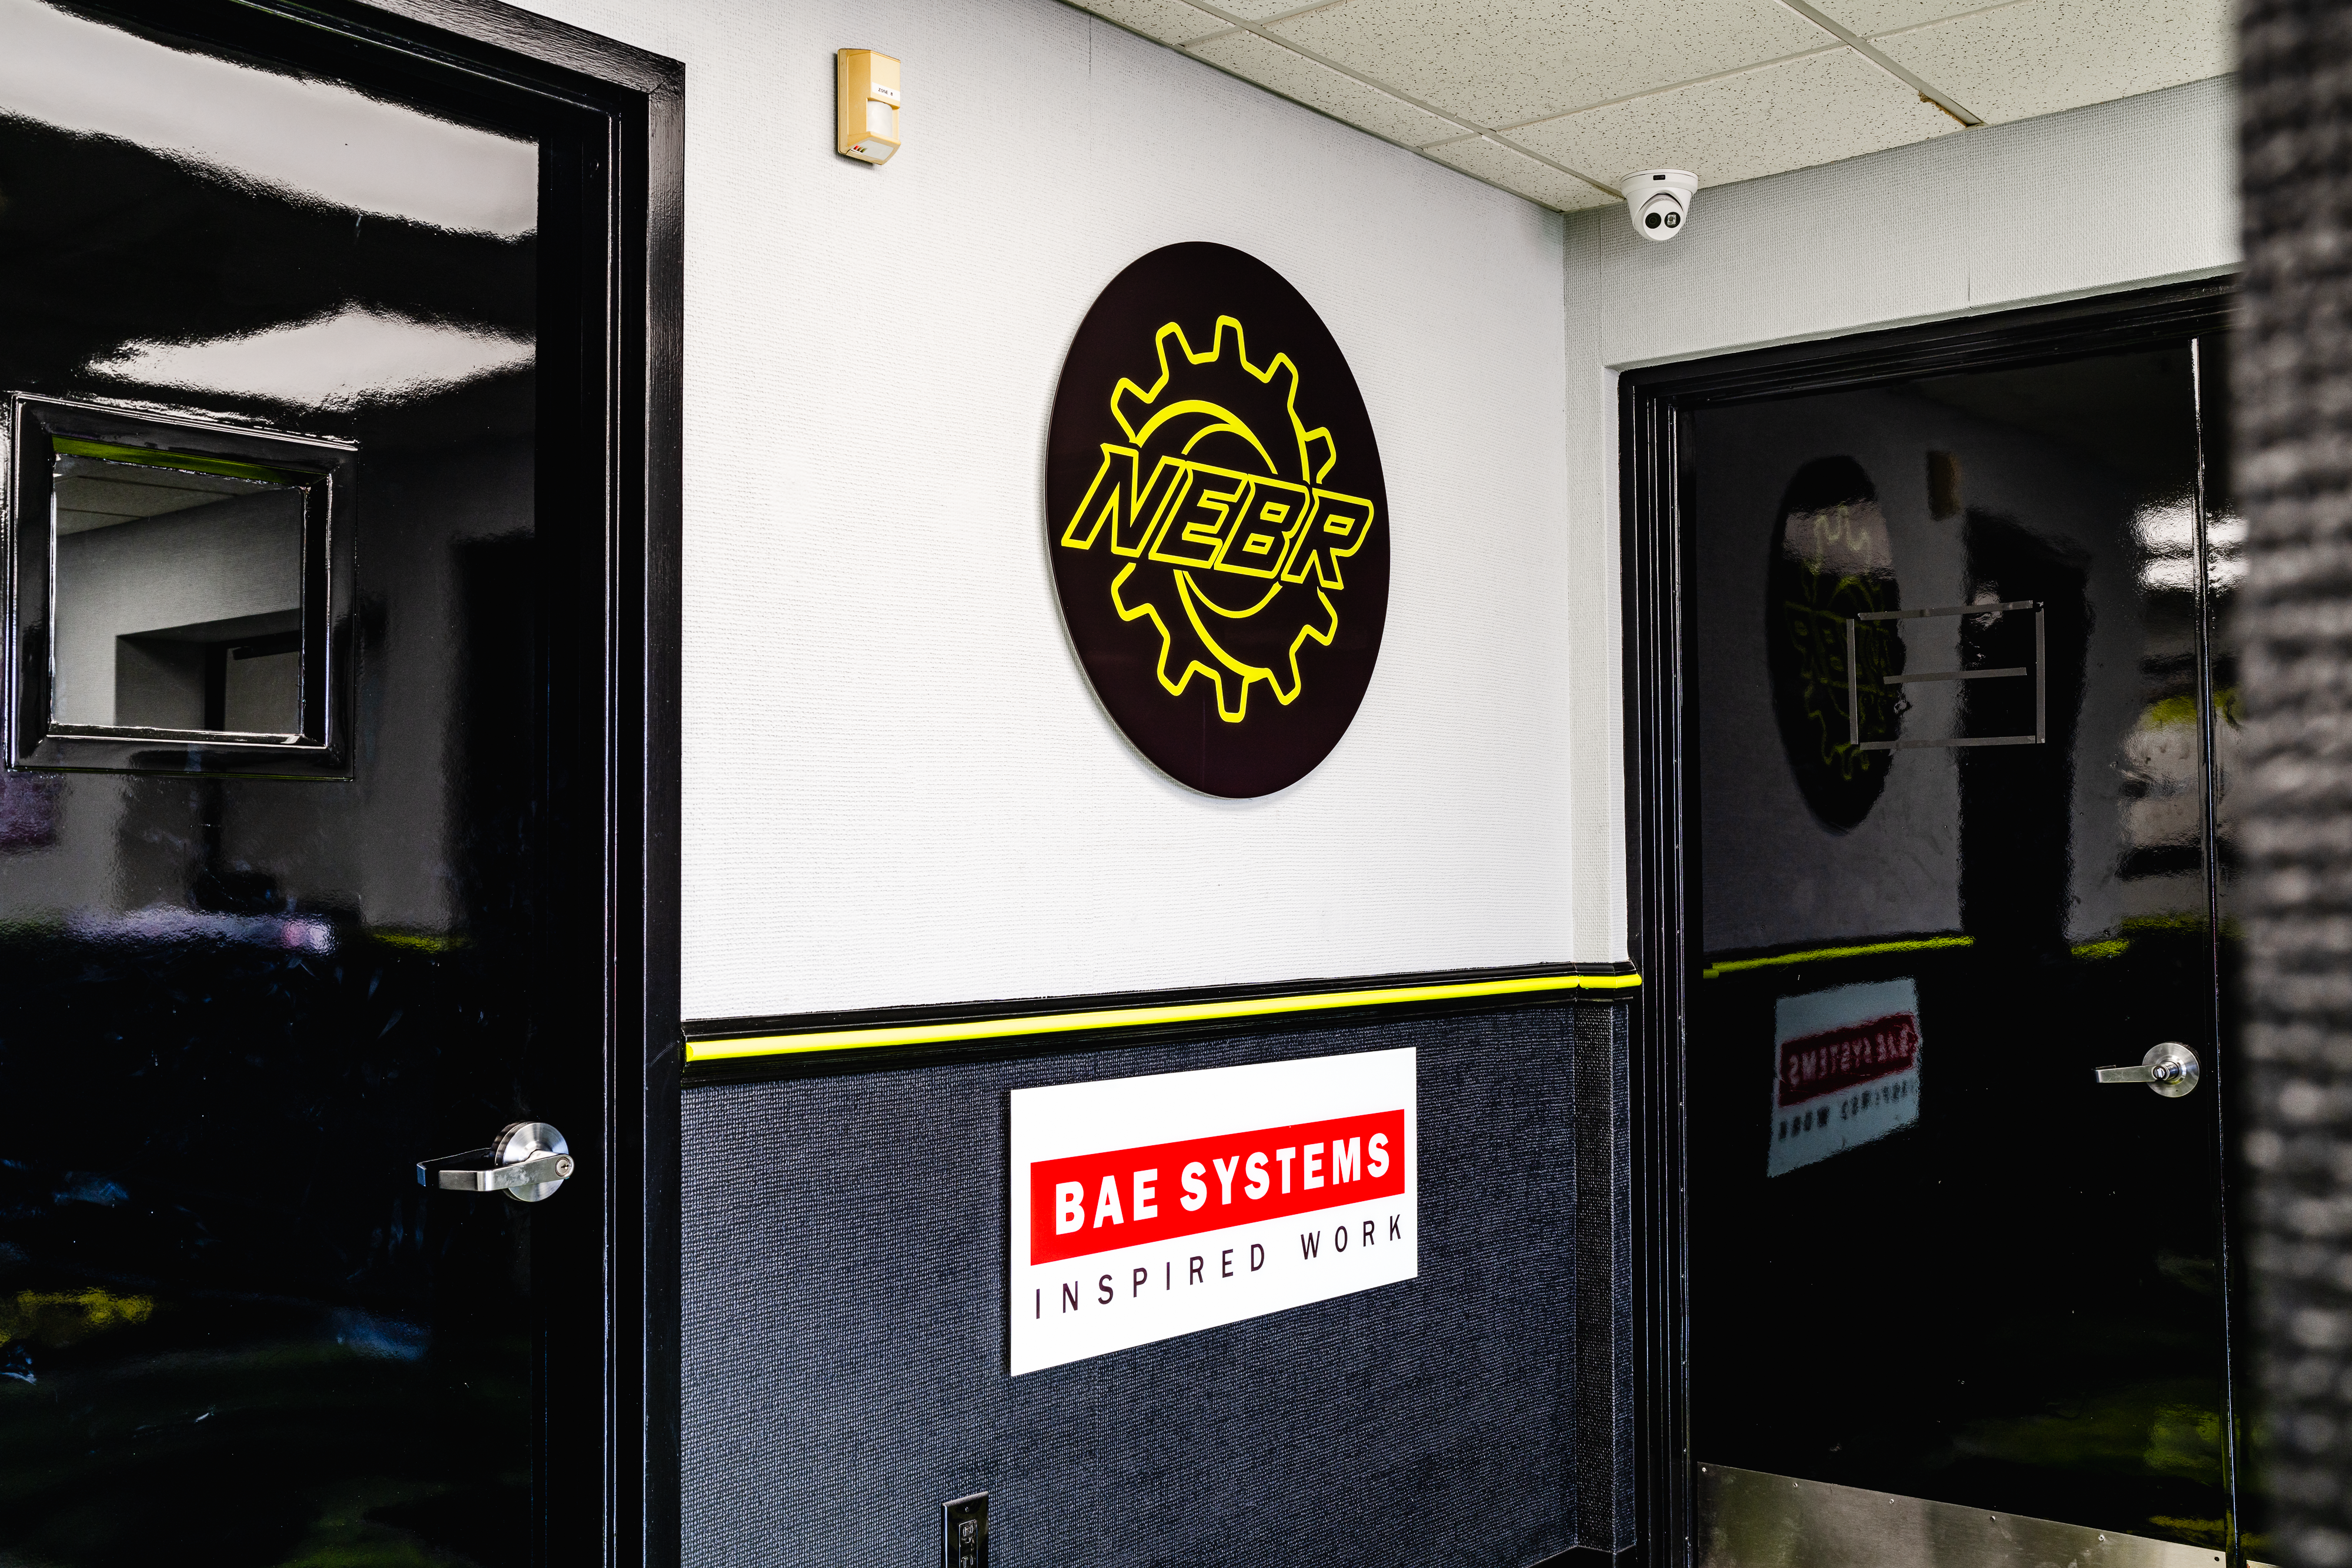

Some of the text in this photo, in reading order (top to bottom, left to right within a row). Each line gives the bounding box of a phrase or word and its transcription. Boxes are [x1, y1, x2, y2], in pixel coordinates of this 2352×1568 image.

[1061, 443, 1374, 590] NEBR
[1055, 1132, 1390, 1235] BAE SYSTEMS
[1035, 1214, 1402, 1319] INSPIRED WORK
